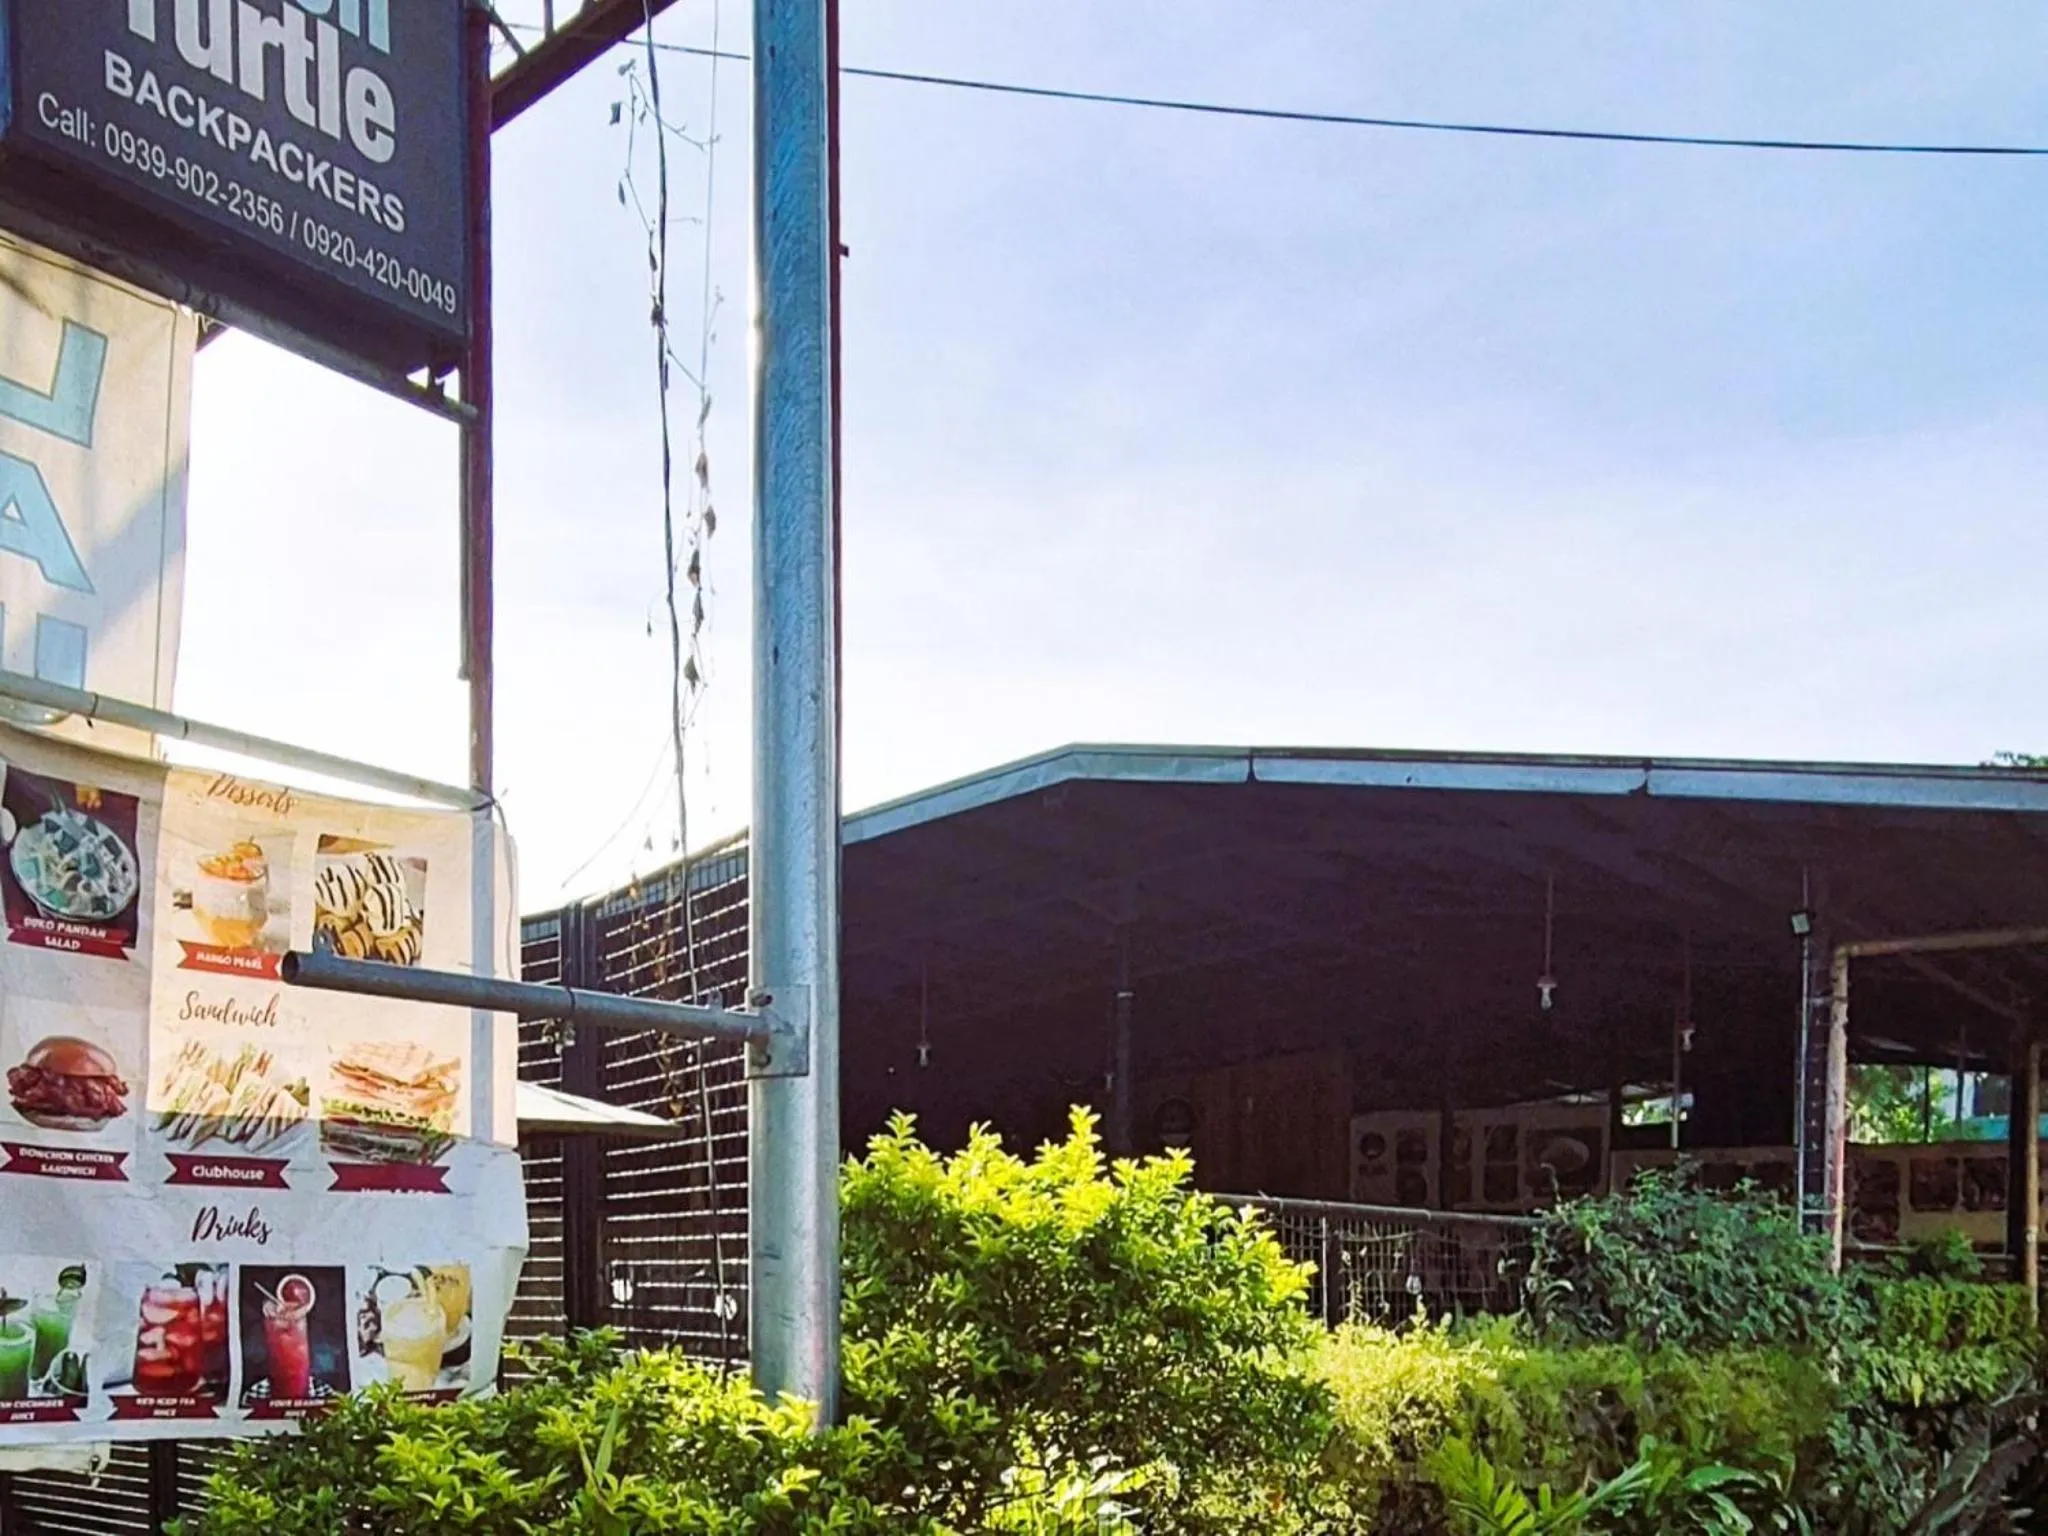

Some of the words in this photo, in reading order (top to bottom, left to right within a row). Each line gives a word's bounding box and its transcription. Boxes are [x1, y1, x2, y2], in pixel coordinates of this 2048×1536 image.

[104, 49, 405, 232] BACKPACKERS
[38, 91, 97, 147] Call:
[104, 122, 285, 235] 0939-902-2356
[288, 210, 299, 241] /
[303, 217, 457, 315] 0920-420-0049
[44, 935, 81, 951] SALAD
[57, 922, 107, 939] PANDAN
[179, 990, 281, 1027] Sandwich
[191, 1165, 265, 1180] Clubhouse
[191, 1205, 273, 1246] Drinks
